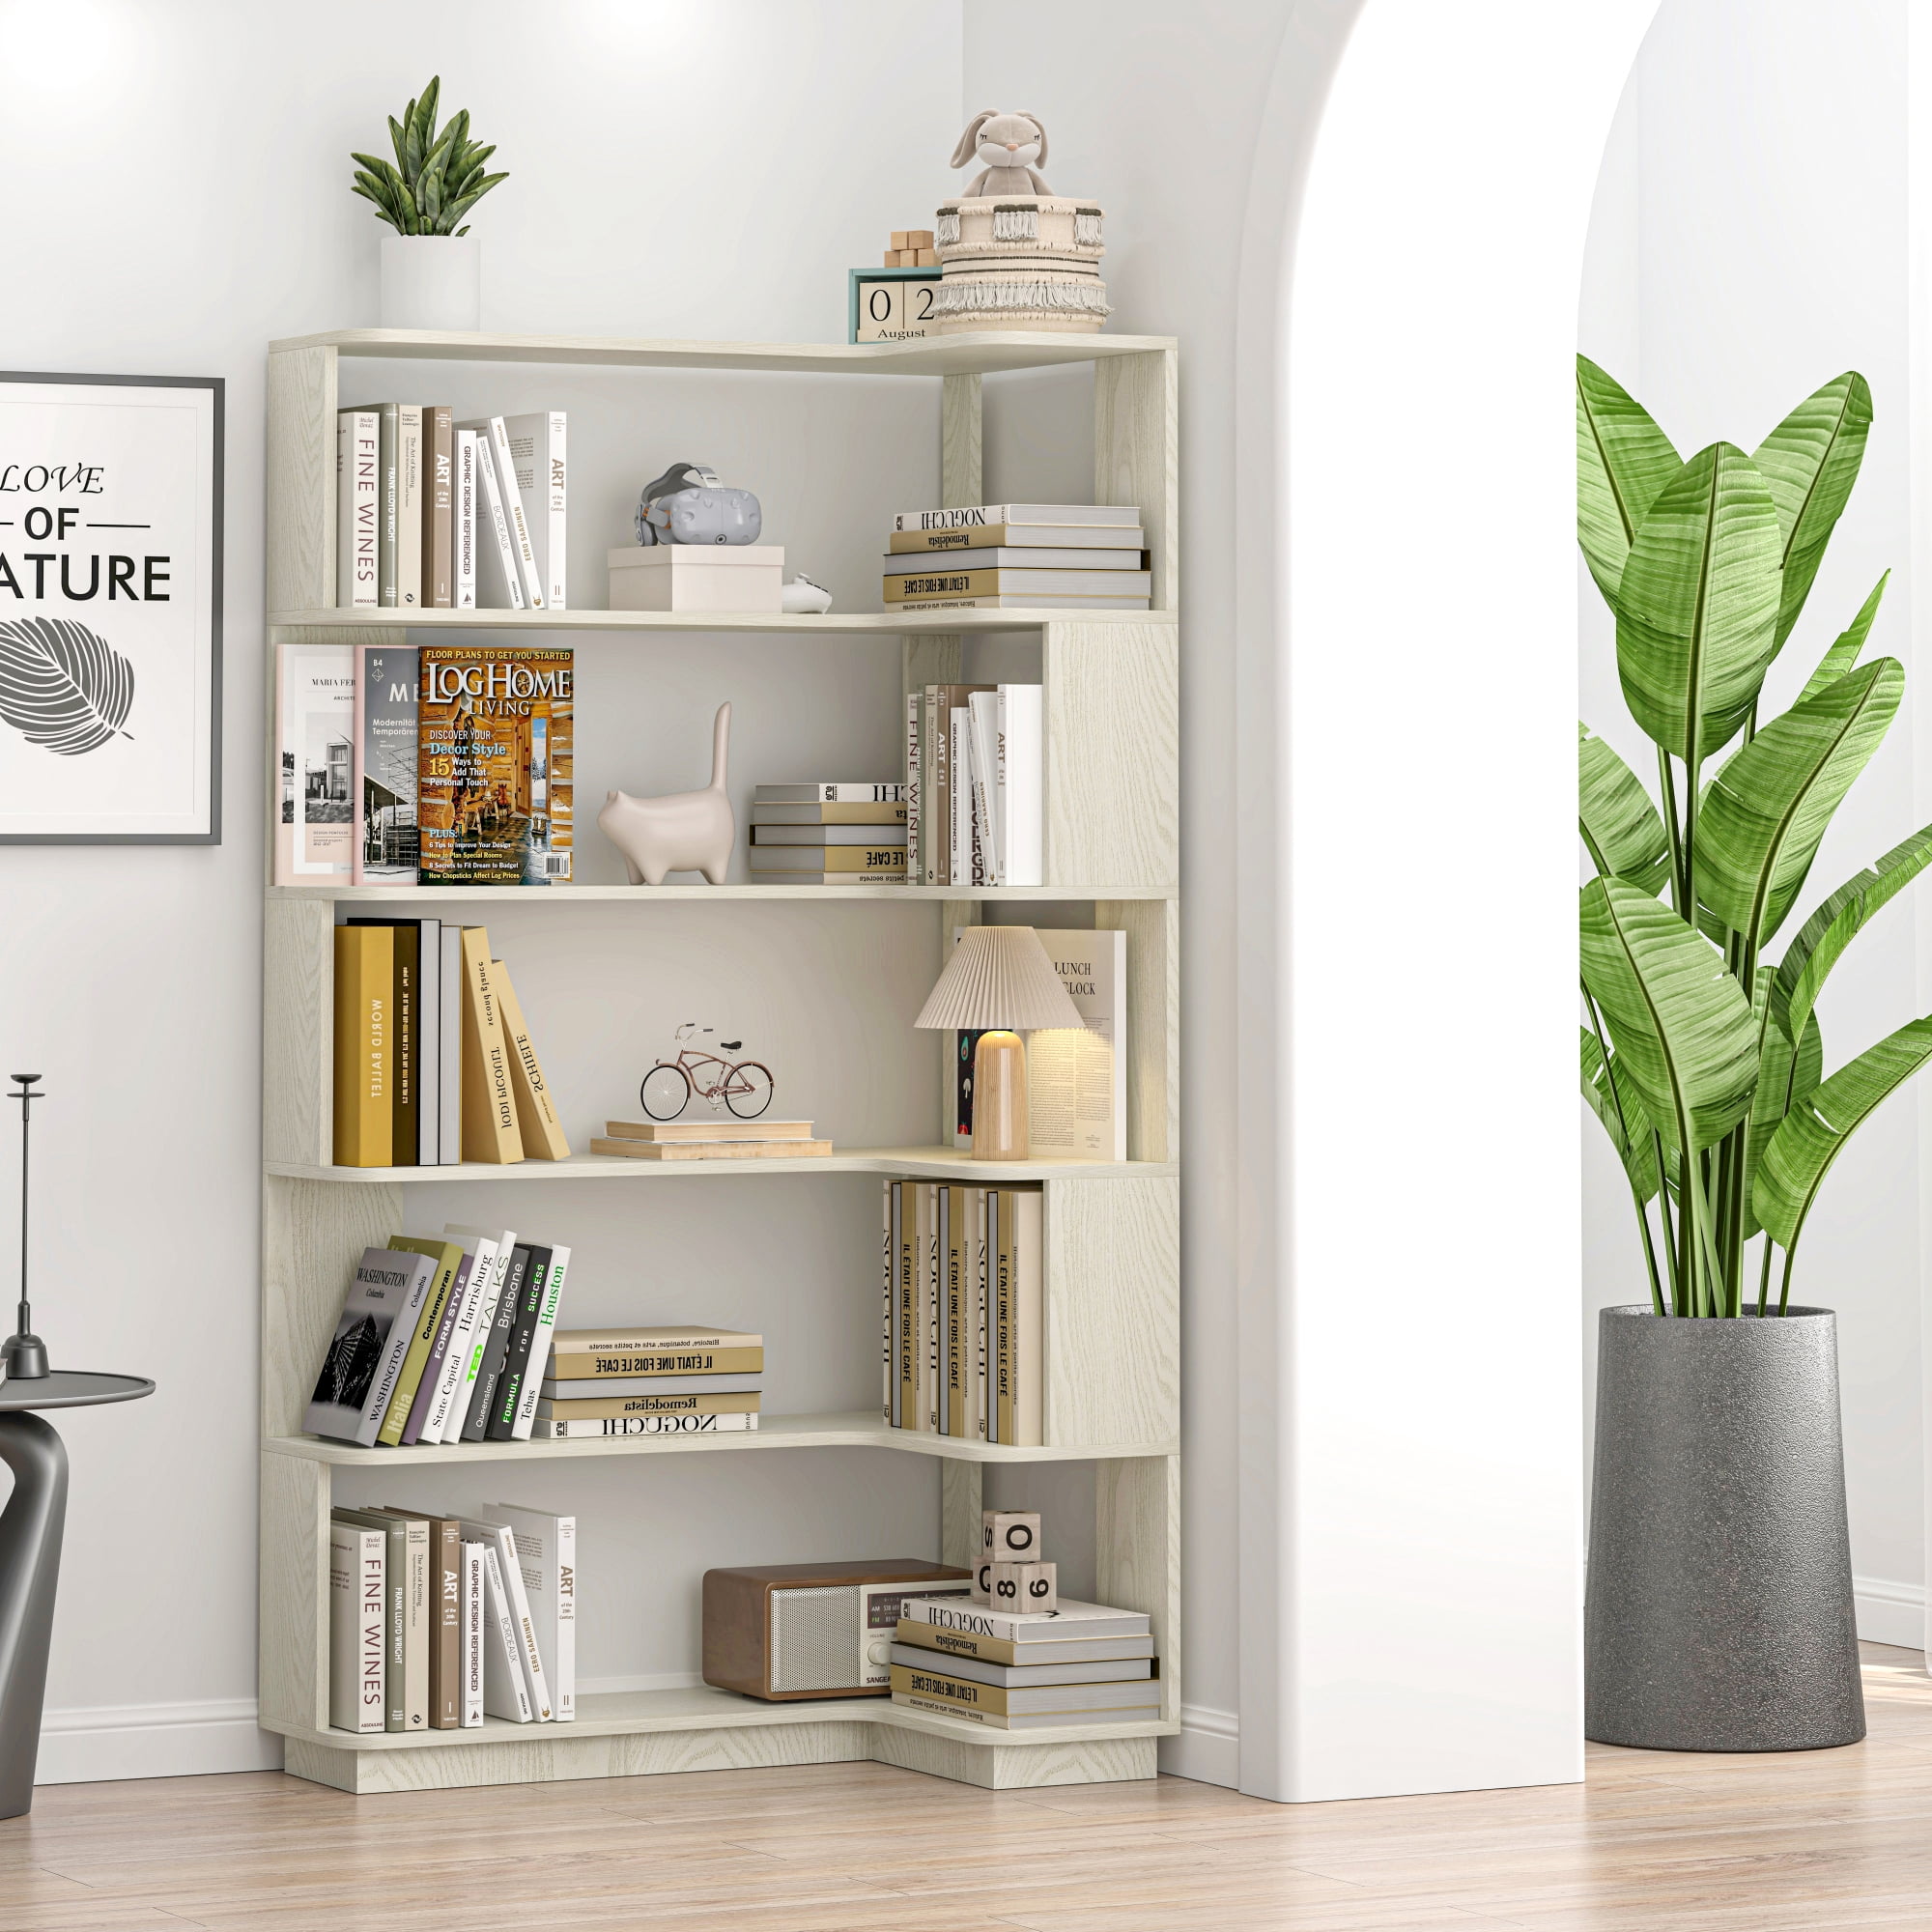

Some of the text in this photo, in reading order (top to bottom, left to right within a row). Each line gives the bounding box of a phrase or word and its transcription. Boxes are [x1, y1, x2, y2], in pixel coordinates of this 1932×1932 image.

[877, 328, 925, 341] August
[0, 463, 104, 495] LOVE
[358, 440, 375, 491] FINE
[437, 454, 450, 487] ART
[552, 458, 564, 490] ART
[24, 506, 79, 541] OF
[494, 505, 509, 551] BORDEAUX
[514, 506, 531, 561] EERO SAARINEN
[922, 508, 985, 529] NOGUCHI
[357, 503, 375, 581] WINES
[463, 519, 471, 575] REFERENCED
[928, 533, 970, 548] Remodelista
[426, 650, 452, 659] FLOOR
[373, 718, 415, 726] Modernität
[469, 700, 530, 716] LIVING
[429, 729, 491, 740] DISCOVER YOUR
[429, 742, 506, 757] Decor Style
[429, 757, 450, 776] 15
[451, 757, 471, 766] Ways
[429, 778, 489, 786] Personal Touch
[451, 767, 487, 776] Add That
[909, 721, 918, 859] FINE WINES
[429, 829, 458, 838] PLUS:
[867, 851, 904, 868] LE CAFÉ
[1054, 962, 1092, 976] LUNCH
[1000, 1255, 1007, 1264] IL
[356, 1266, 409, 1288] WASHINGTON
[365, 1288, 385, 1299] Columbia
[435, 1274, 467, 1359] FORM STYLE
[466, 1255, 509, 1383] TED TALKS
[369, 1275, 427, 1422] WASHINGTON Columbia
[386, 1269, 451, 1435] Italia Contemporan
[433, 1254, 493, 1428] State Capital Harrisburg
[475, 1263, 524, 1428] Queensland Brisbane
[502, 1264, 545, 1423] FORMULA FOR SUCCESS
[521, 1264, 564, 1420] Tehas Houston
[1000, 1352, 1007, 1366] LE
[443, 1570, 458, 1603] ART
[560, 1565, 574, 1597] ART
[997, 1579, 1016, 1599] 8
[363, 1559, 382, 1705] FINE WINES
[394, 1587, 403, 1664] FRANK LLOYD WRIGHT
[928, 1606, 994, 1636] NOGUCHI
[500, 1616, 518, 1663] BORDEAUX
[523, 1616, 540, 1673] EERO SAARINEN
[935, 1634, 978, 1655] Remodelista
[470, 1634, 479, 1691] REFERENCED
